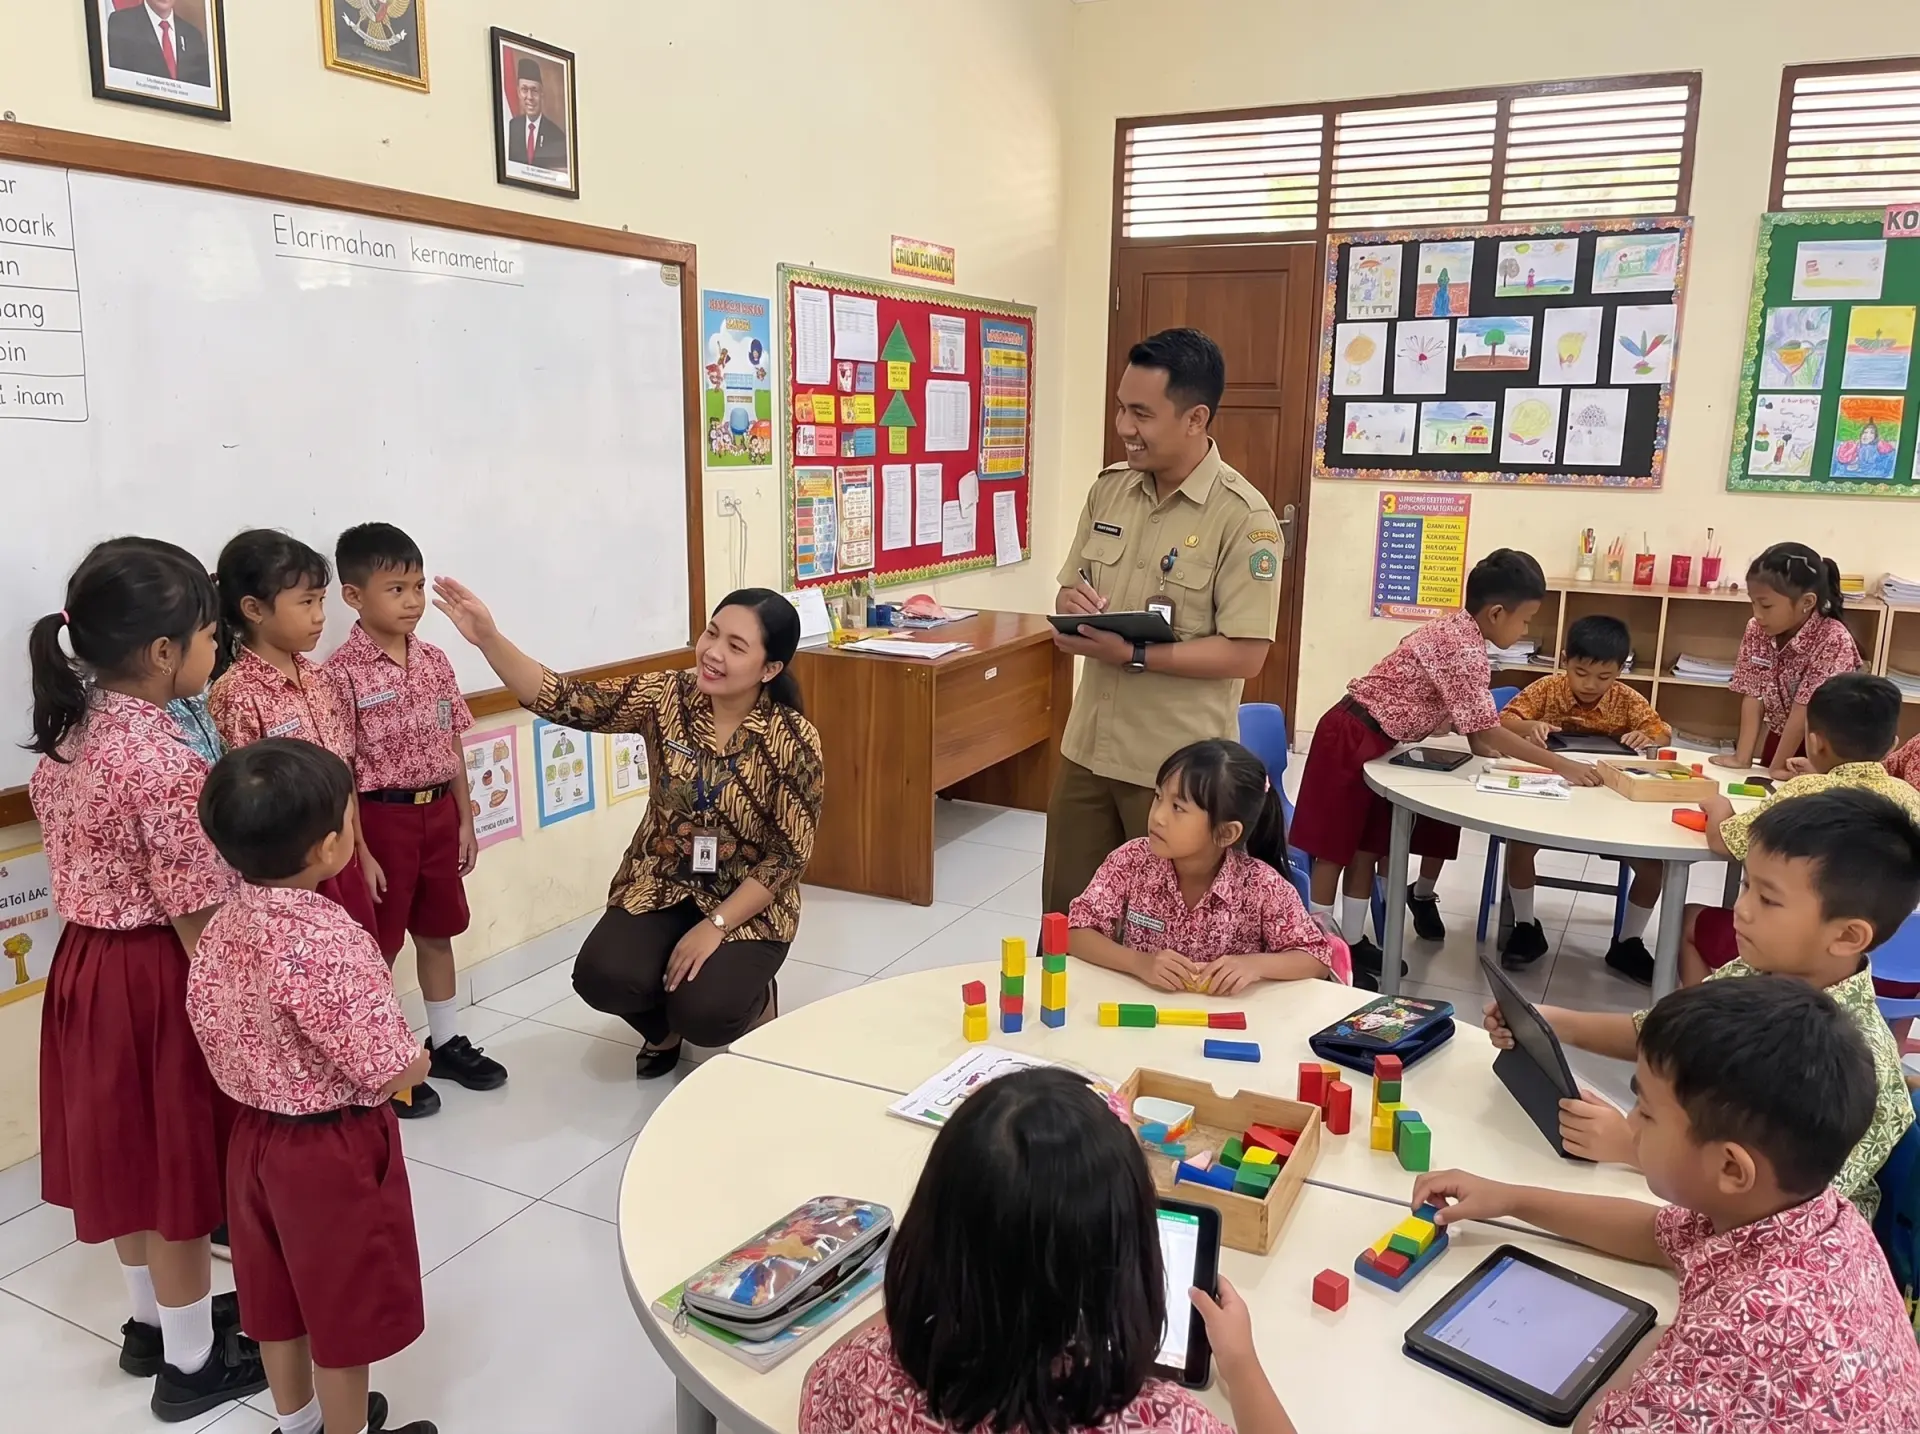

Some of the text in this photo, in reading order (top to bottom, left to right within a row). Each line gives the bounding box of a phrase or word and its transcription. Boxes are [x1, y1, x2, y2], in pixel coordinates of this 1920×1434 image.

[273, 213, 515, 274] Elarimahan kernamentar
[1383, 494, 1397, 513] 3
